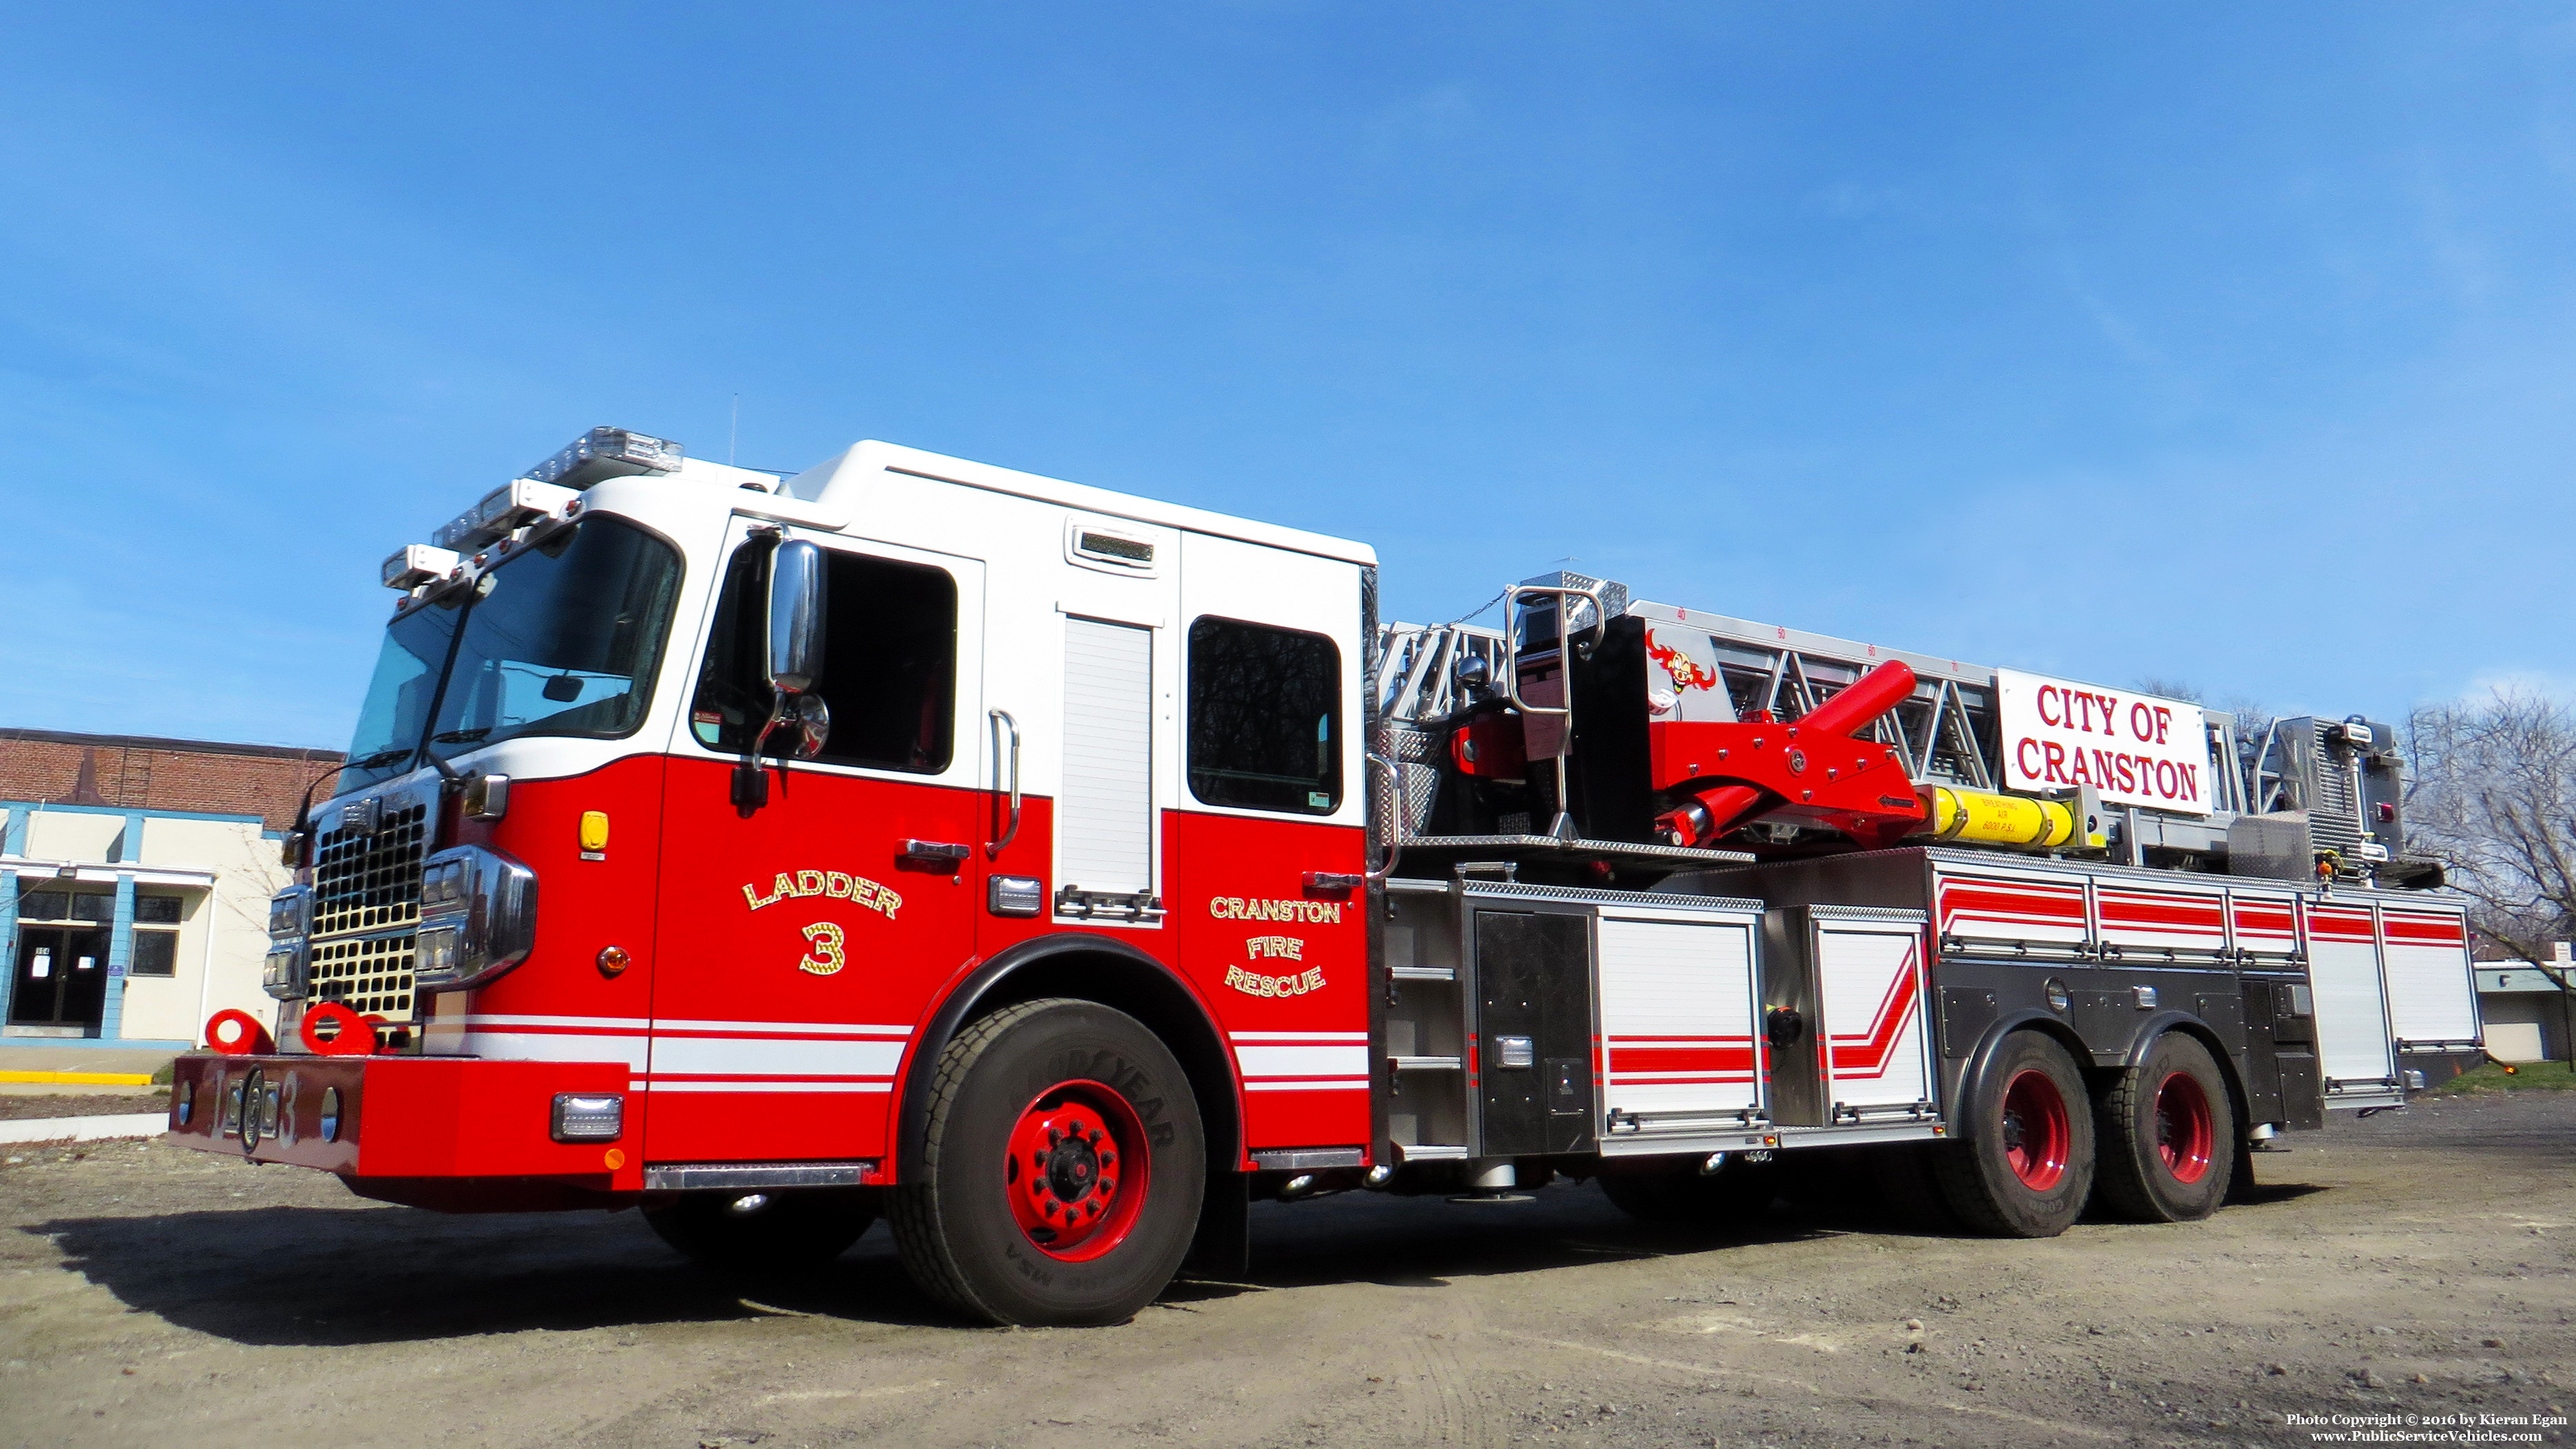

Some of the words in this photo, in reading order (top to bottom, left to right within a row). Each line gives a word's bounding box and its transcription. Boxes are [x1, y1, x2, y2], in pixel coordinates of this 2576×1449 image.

[2037, 684, 2118, 737] CITY
[2131, 702, 2173, 745] OF
[2016, 737, 2198, 802] CRANSTON
[1998, 810, 2008, 819] AIR
[741, 869, 902, 920] LADDER
[1210, 896, 1341, 924] CRANSTON
[799, 922, 845, 975] 3
[1246, 935, 1304, 960] FIRE
[1224, 964, 1327, 997] RESCUE
[279, 1070, 298, 1151] 3
